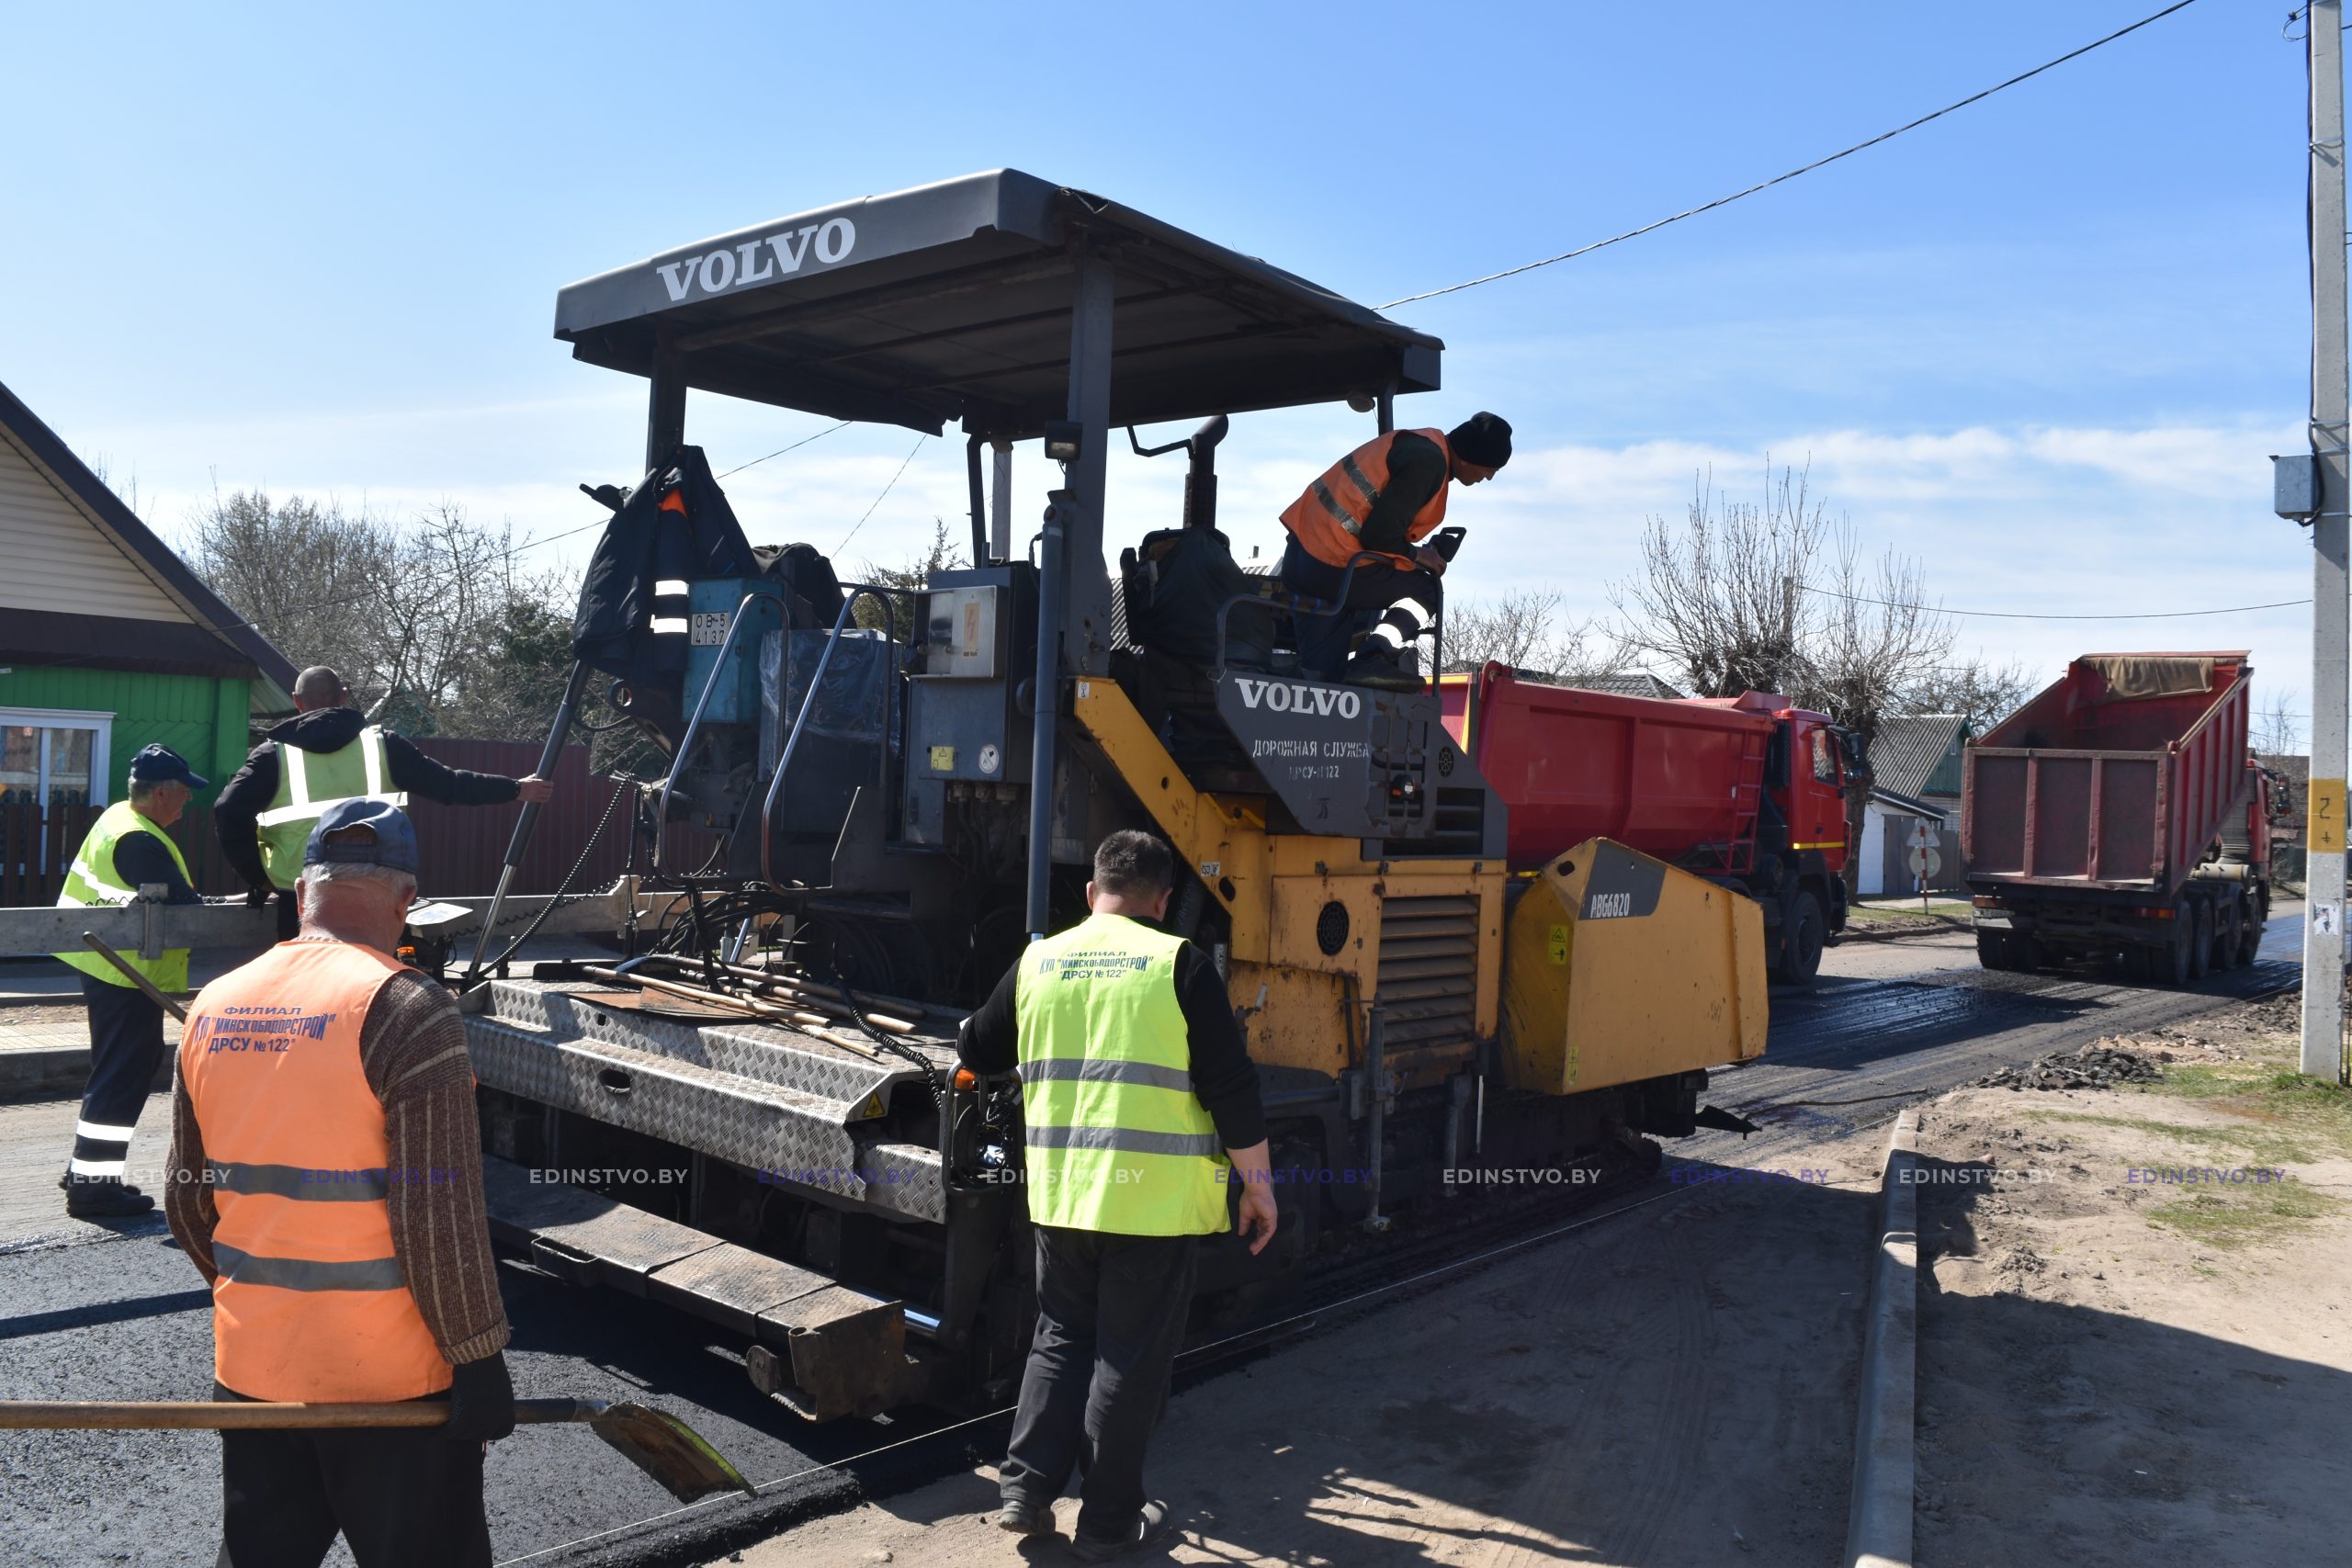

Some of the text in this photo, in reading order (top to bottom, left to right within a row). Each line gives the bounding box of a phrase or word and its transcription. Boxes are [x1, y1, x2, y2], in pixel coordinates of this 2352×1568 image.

[656, 217, 856, 302] VOLVO
[695, 630, 725, 645] 4137
[1235, 678, 1361, 719] VOLVO
[1252, 739, 1370, 758] ДОРОЖНАЯ СЛУЖБА
[1589, 893, 1631, 919] ABG6820
[1038, 958, 1056, 975] КУП
[224, 1006, 302, 1015] ФИЛИАЛ
[209, 1037, 252, 1054] ДРСУ
